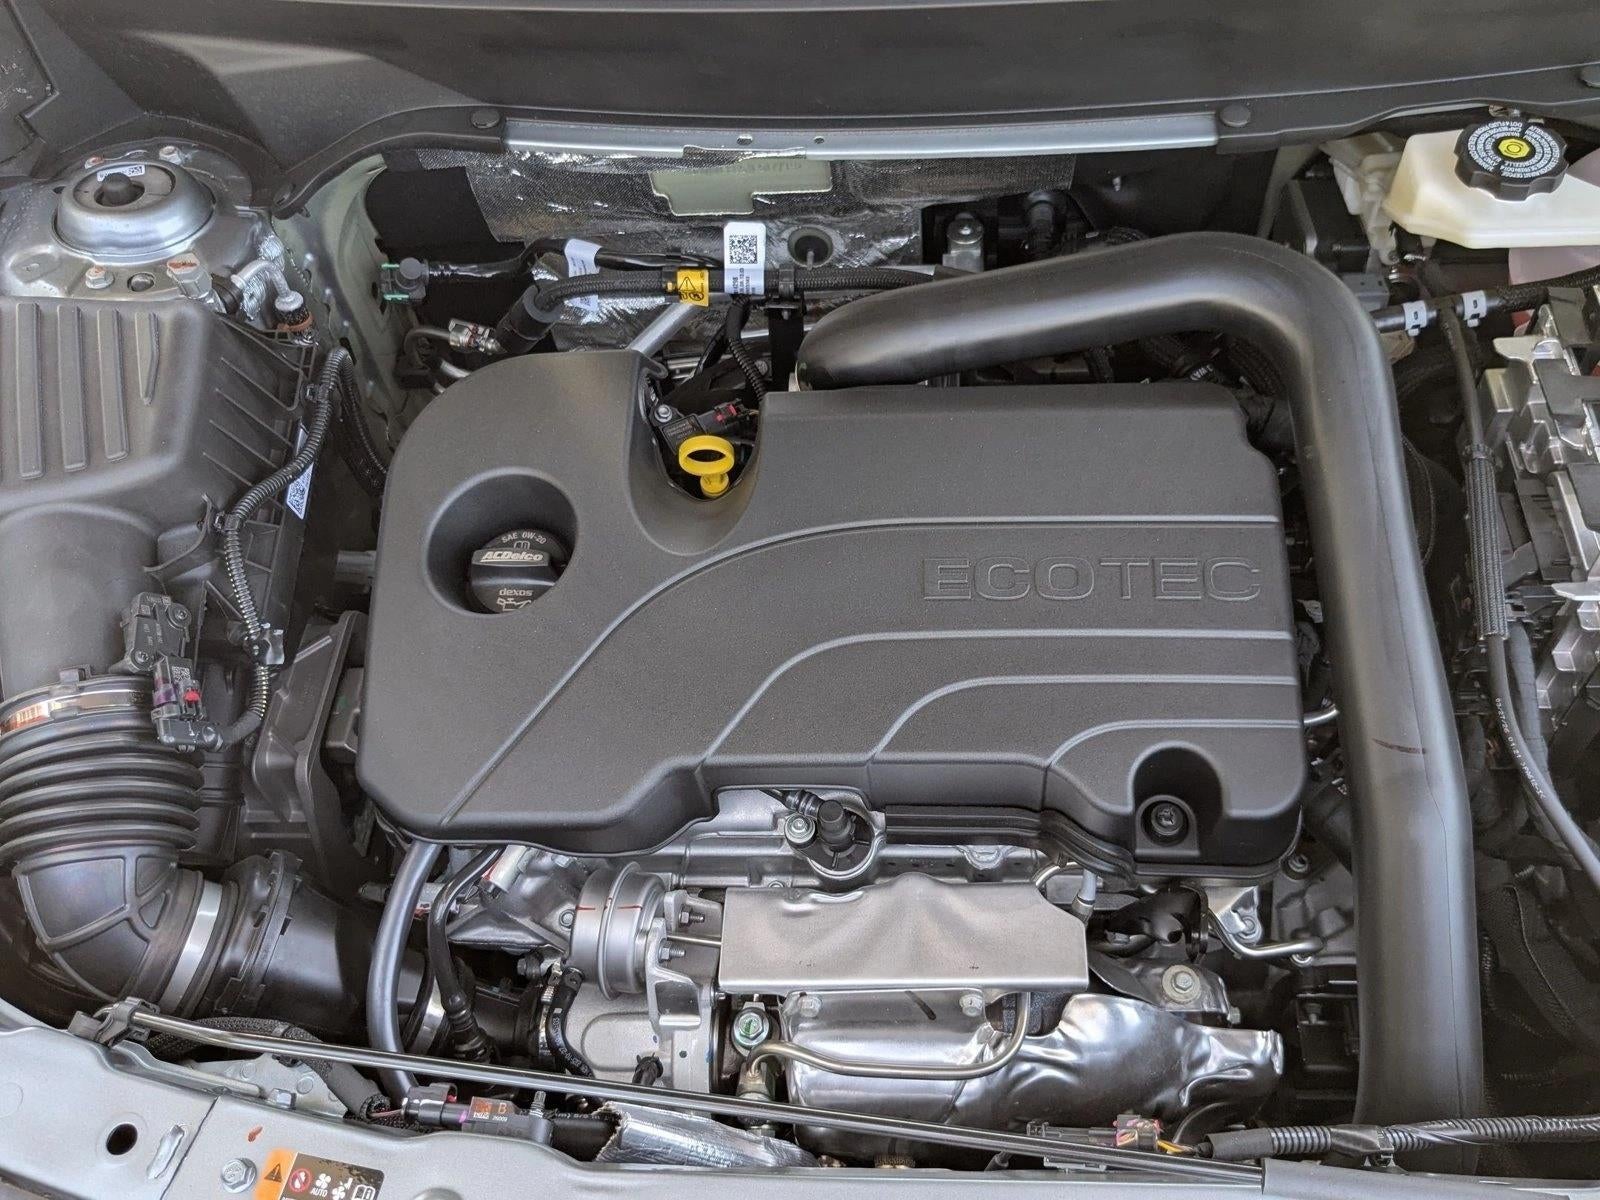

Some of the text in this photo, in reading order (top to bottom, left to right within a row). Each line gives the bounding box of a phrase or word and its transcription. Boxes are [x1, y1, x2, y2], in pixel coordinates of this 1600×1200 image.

[501, 532, 547, 545] SAE 0W-20
[481, 551, 544, 561] ACDelco
[923, 556, 1263, 602] ECOTEC
[499, 588, 534, 596] dexos
[310, 1187, 330, 1198] AUTO
